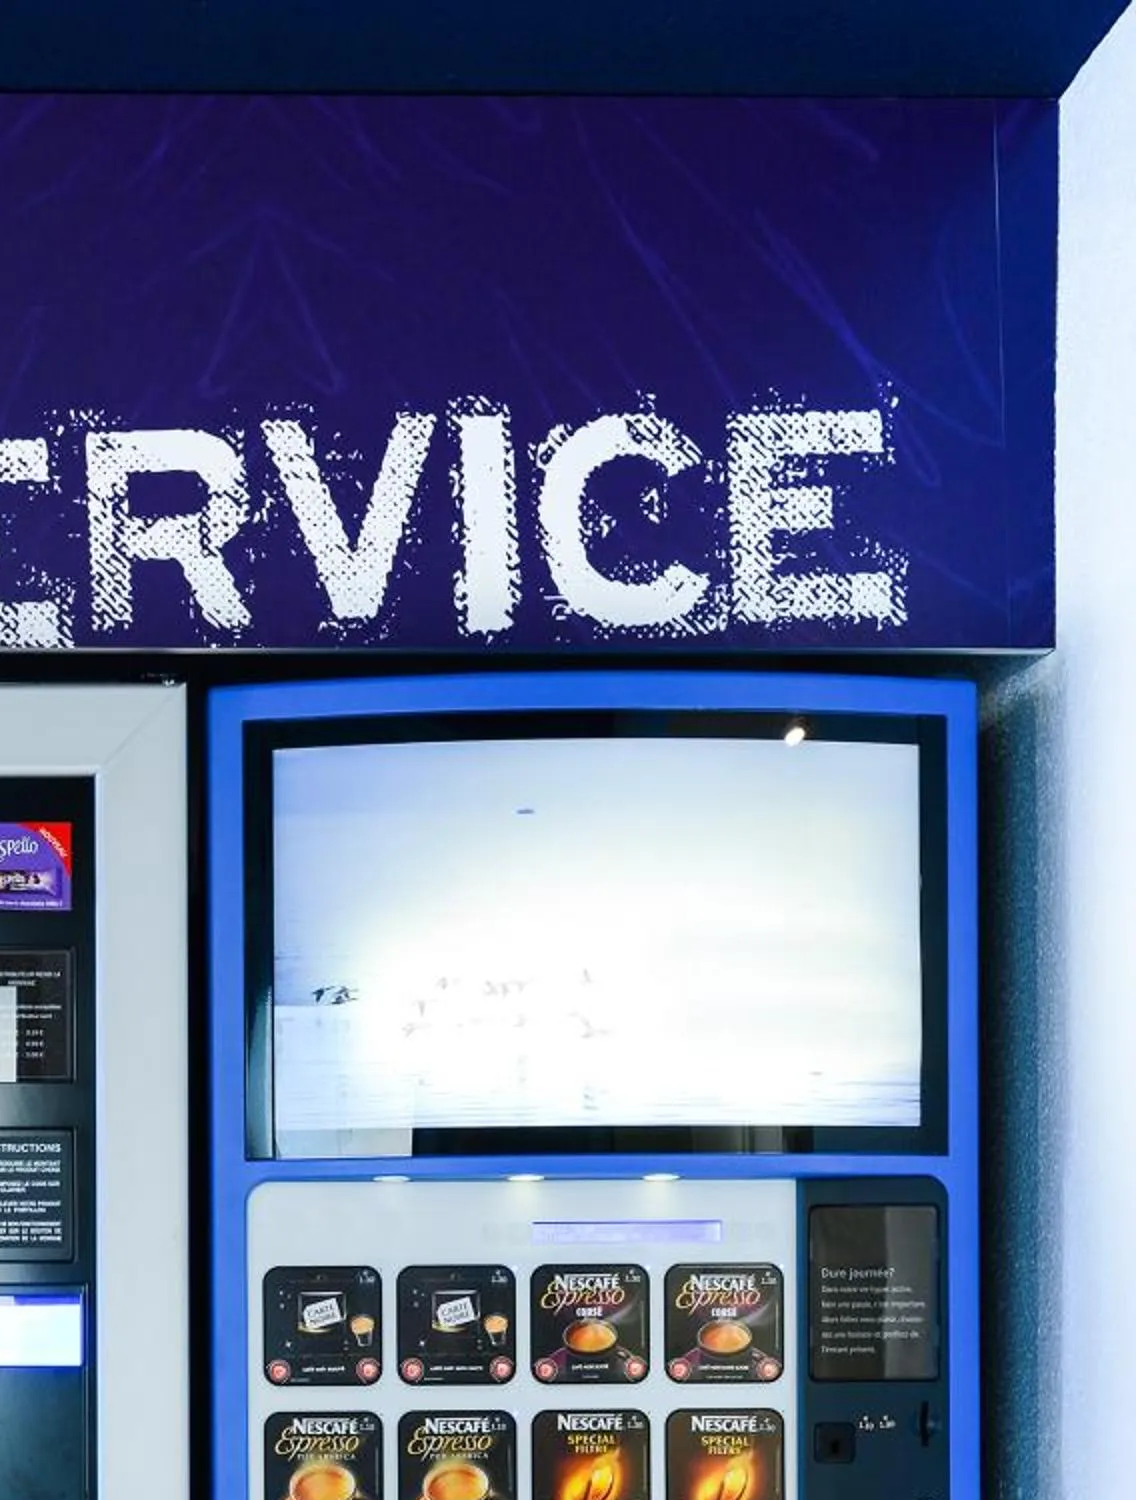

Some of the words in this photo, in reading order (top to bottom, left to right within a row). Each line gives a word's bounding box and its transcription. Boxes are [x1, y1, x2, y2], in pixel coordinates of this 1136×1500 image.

[541, 1281, 625, 1316] Espresso
[675, 1281, 761, 1316] Espresso
[425, 1417, 491, 1434] NESCAFÉ
[557, 1413, 623, 1431] NESCAFÉ
[691, 1415, 758, 1432] NESCAFÉ
[275, 1427, 360, 1462] Espresso
[407, 1425, 493, 1462] Espresso
